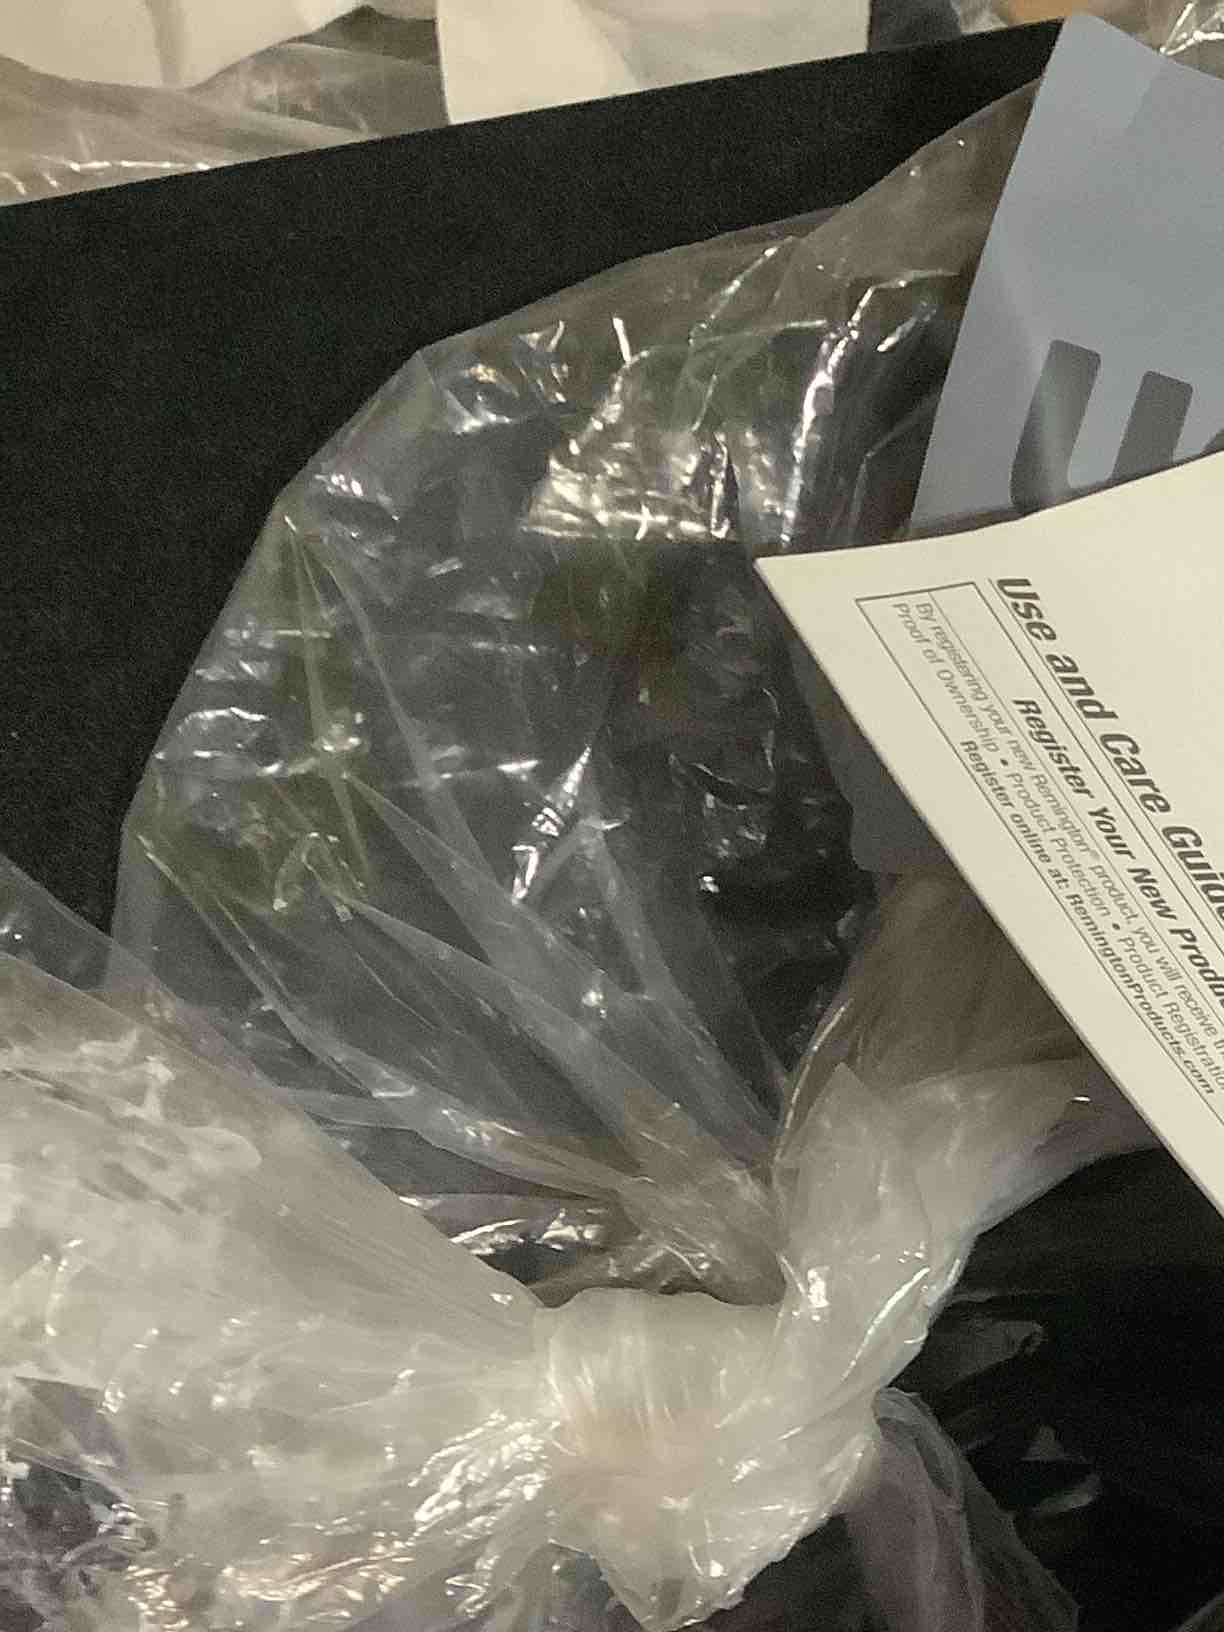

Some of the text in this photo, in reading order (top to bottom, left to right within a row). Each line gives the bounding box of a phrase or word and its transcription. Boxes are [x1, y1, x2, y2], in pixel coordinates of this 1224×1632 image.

[960, 741, 1015, 808] Register
[1010, 813, 1052, 863] online
[998, 577, 1056, 641] Use
[1045, 655, 1117, 719] and
[1099, 734, 1170, 813] Care
[1012, 700, 1095, 799] Register
[1088, 807, 1136, 859] Your
[1127, 868, 1178, 920] New
[922, 649, 946, 664] of
[936, 669, 1000, 752] Ownership
[1003, 772, 1057, 835] Product
[1049, 837, 1111, 917] Protection
[1117, 935, 1170, 999] Product
[978, 702, 1013, 736] your
[1131, 929, 1160, 954] you
[1155, 956, 1183, 981] will
[1173, 984, 1218, 1037] receive
